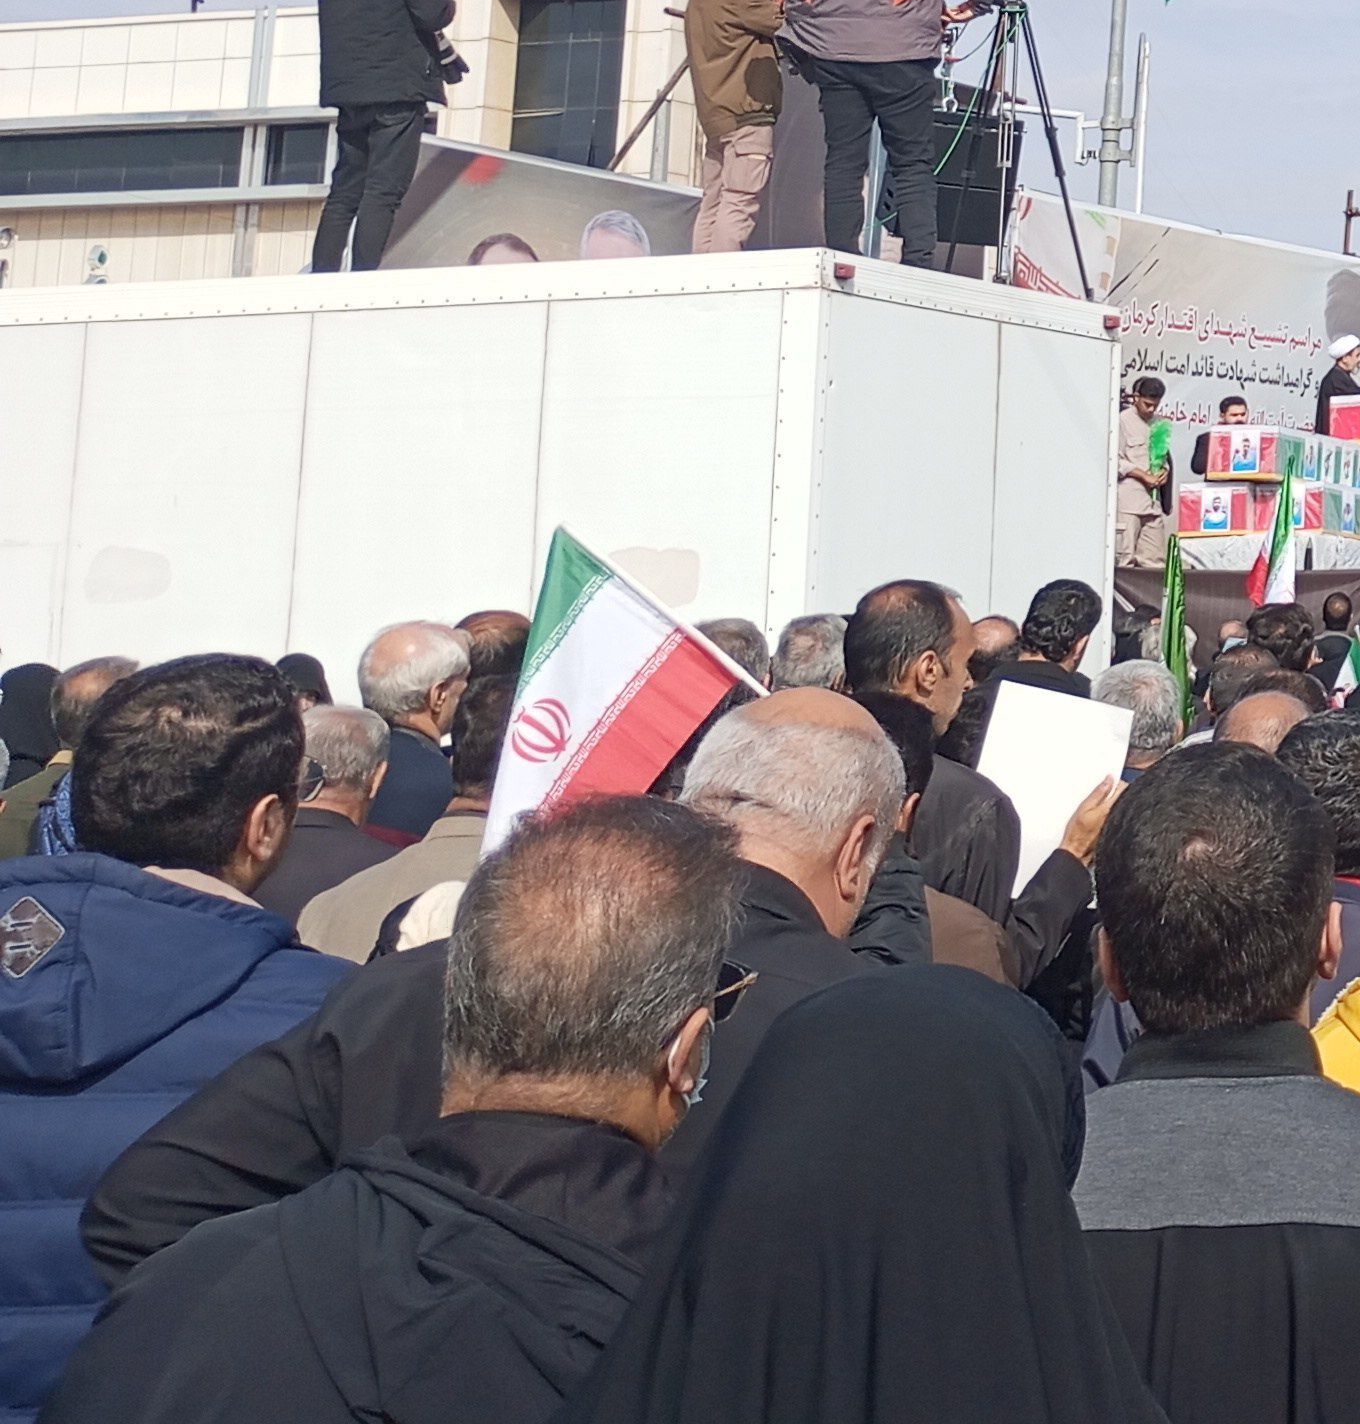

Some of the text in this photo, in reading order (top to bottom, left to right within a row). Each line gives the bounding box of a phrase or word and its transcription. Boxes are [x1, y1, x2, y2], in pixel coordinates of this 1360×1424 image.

[1120, 298, 1324, 356] مراسم تشییع شهدای اقتدار کرمان
[1120, 347, 1164, 378] اسلامی
[1165, 352, 1190, 375] امت
[1191, 355, 1214, 377] قائد
[1216, 359, 1257, 390] شهادت
